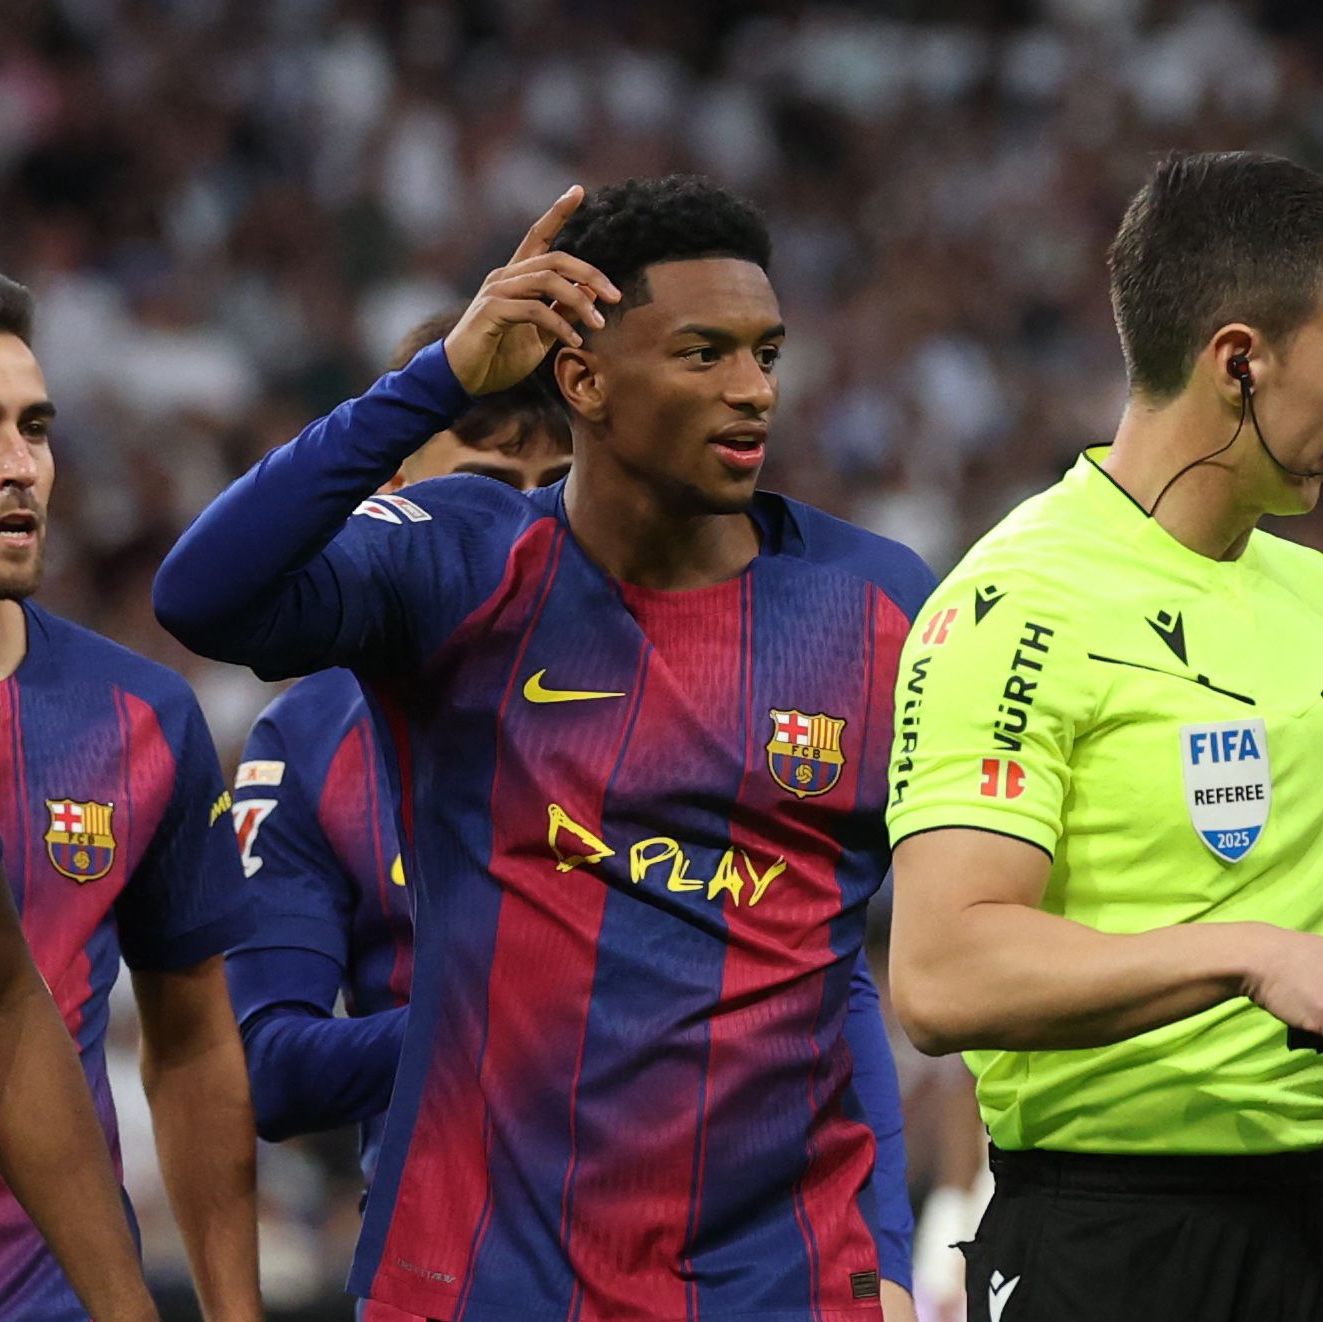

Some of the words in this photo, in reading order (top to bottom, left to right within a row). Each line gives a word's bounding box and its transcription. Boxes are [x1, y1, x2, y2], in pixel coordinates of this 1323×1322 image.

[791, 745, 821, 759] FCB
[1189, 728, 1261, 765] FIFA
[1194, 784, 1265, 806] REFEREE
[1216, 831, 1250, 849] 2025
[629, 836, 787, 908] PLAY
